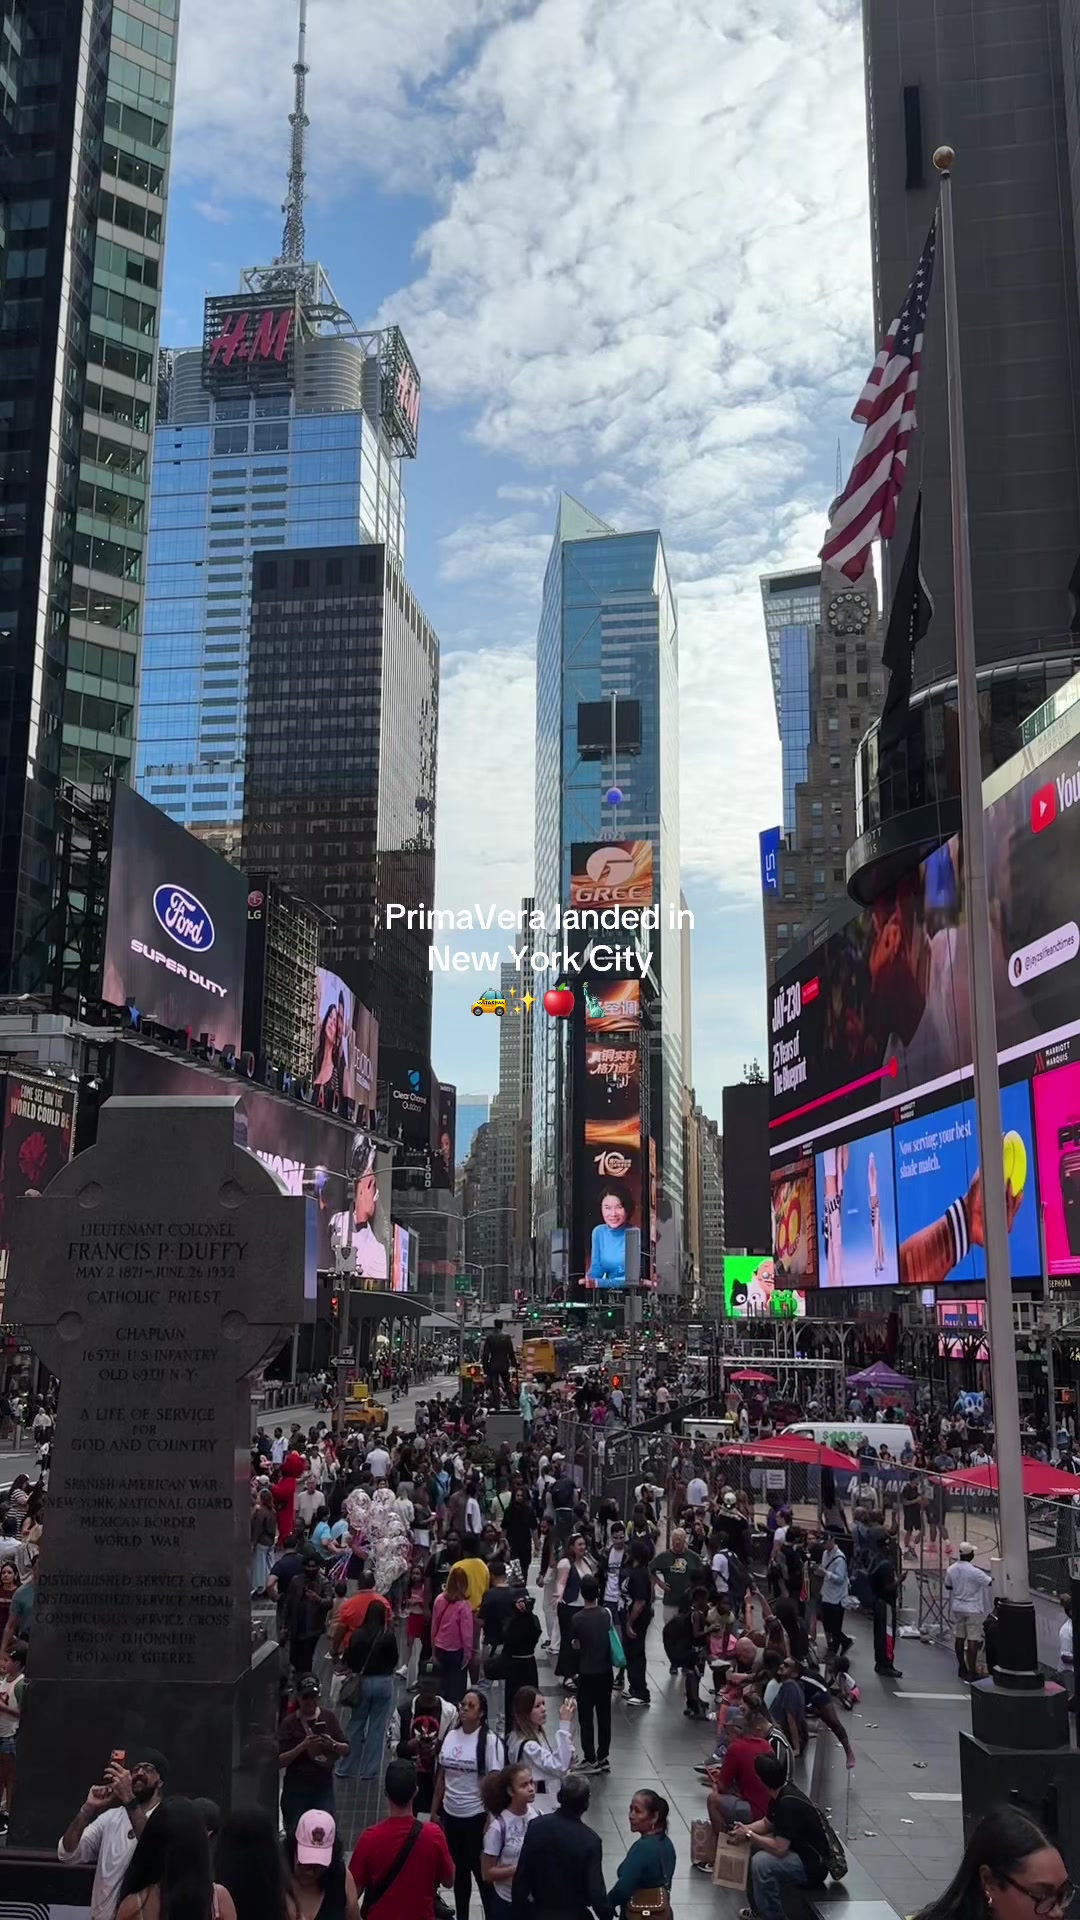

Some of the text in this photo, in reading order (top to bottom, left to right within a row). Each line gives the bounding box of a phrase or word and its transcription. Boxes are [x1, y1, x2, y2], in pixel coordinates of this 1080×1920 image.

[209, 309, 294, 366] H&M
[575, 886, 644, 902] GREE
[165, 892, 204, 945] Ford
[247, 910, 262, 920] LG
[130, 939, 228, 998] SUPER DUTY
[1045, 1041, 1071, 1057] MARRIOTT
[1045, 1052, 1069, 1067] MARQUIS
[34, 1088, 43, 1103] SEE
[55, 1093, 64, 1108] THE
[392, 1090, 411, 1101] Clear
[10, 1097, 71, 1129] WORLD COULD BE
[938, 1128, 955, 1149] your
[955, 1119, 972, 1140] best
[900, 1158, 918, 1179] shade
[80, 1223, 235, 1237] LIEUTENANT COLONEL
[68, 1242, 151, 1261] FRANCIS
[179, 1242, 248, 1261] DUFFY
[76, 1266, 103, 1278] MAY
[107, 1266, 115, 1278] 2
[189, 1266, 203, 1278] 26
[207, 1266, 235, 1278] 1932
[1048, 1279, 1072, 1289] SEPHORA
[87, 1290, 221, 1304] CATHOLIC PRIEST
[116, 1327, 186, 1341] CHAPLAIN
[82, 1349, 120, 1362] 165TH
[154, 1349, 218, 1362] INFANTRY
[99, 1368, 128, 1381] OLD
[132, 1368, 164, 1381] 69TH
[79, 1408, 215, 1421] A LIFE OF SERVICE
[132, 1424, 156, 1435] FOR
[71, 1438, 218, 1452] GOD AND COUNTRY
[189, 1478, 217, 1490] WAR
[48, 1497, 233, 1510] NEW YORK NATIONAL GUARD
[80, 1516, 196, 1528] MEXICAN BORDER
[94, 1535, 180, 1547] WORLD WAR
[38, 1574, 231, 1587] DISTINGUISHED SERVICE CROSS
[36, 1592, 233, 1608] DISTINGUISHED SERVICE MEDAL
[135, 1613, 184, 1626] SERVICE
[189, 1613, 231, 1626] CROSS
[65, 1651, 196, 1665] CROIX DE GUERRE
